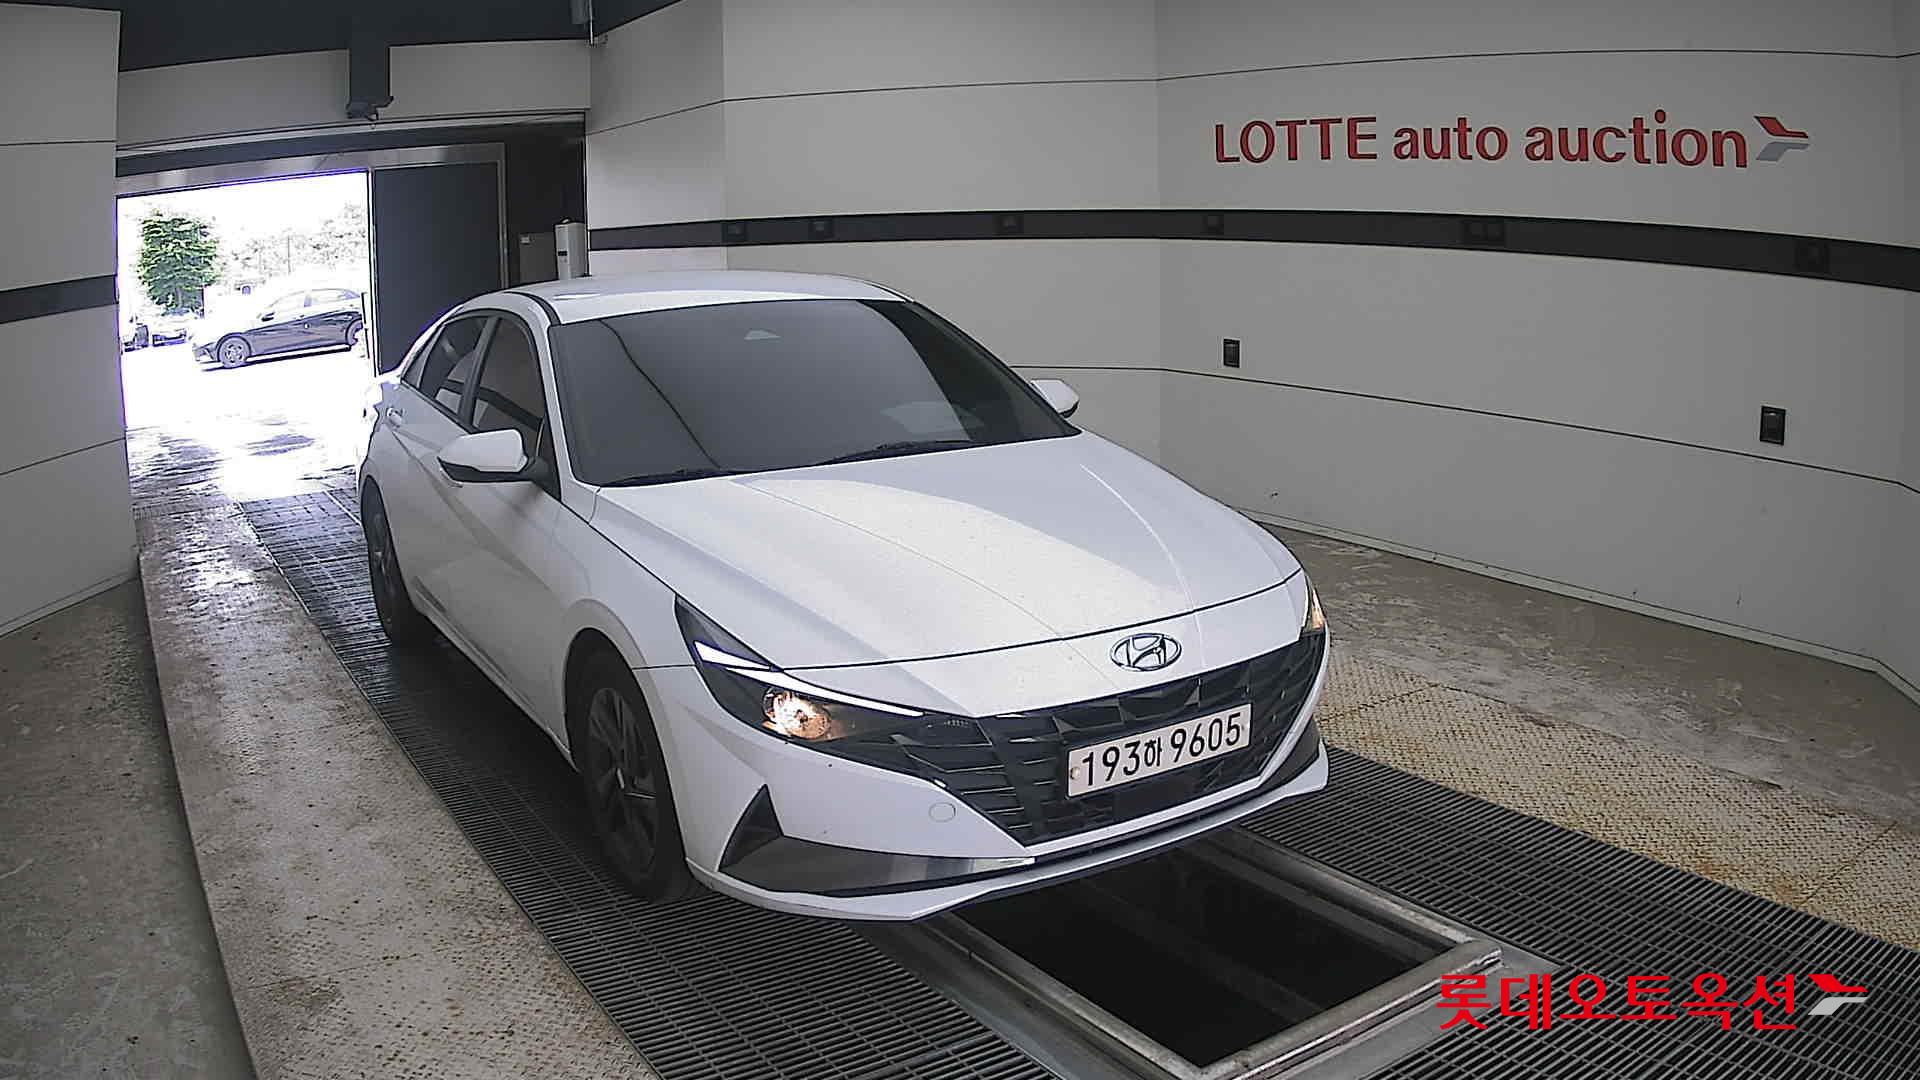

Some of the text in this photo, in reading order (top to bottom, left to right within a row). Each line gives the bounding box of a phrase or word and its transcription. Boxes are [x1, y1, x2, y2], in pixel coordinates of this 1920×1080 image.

[1215, 109, 1748, 168] LOTTE auto auction
[1170, 712, 1242, 763] 9605
